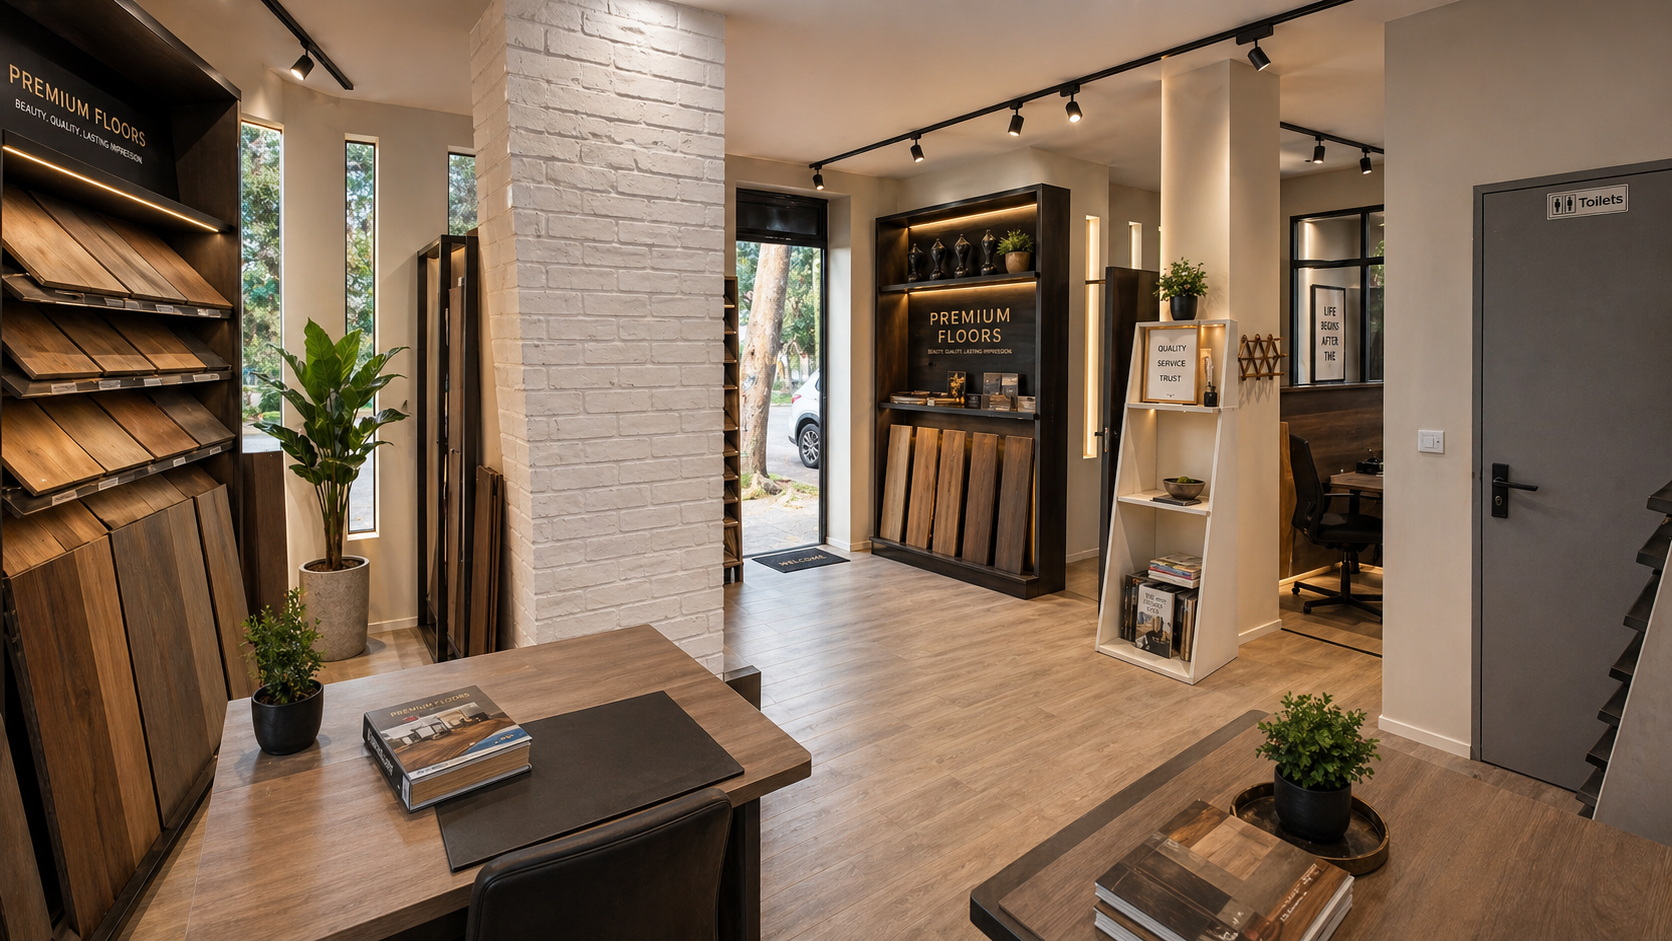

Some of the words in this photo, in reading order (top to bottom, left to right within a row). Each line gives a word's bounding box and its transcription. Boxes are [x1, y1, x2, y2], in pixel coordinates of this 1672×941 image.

[9, 63, 90, 120] PREMIUM
[95, 107, 147, 148] FLOORS
[83, 130, 110, 149] LASTING
[1578, 194, 1624, 208] Toilets
[930, 307, 1010, 326] PREMIUM
[1323, 306, 1337, 317] LIFE
[938, 328, 1002, 344] FLOORS
[1321, 336, 1339, 346] AFTER
[1157, 344, 1187, 353] QUALITY
[1324, 351, 1337, 361] THE
[1157, 359, 1186, 367] SERVICE
[1159, 374, 1182, 382] TRUST
[778, 555, 827, 566] WELCOME
